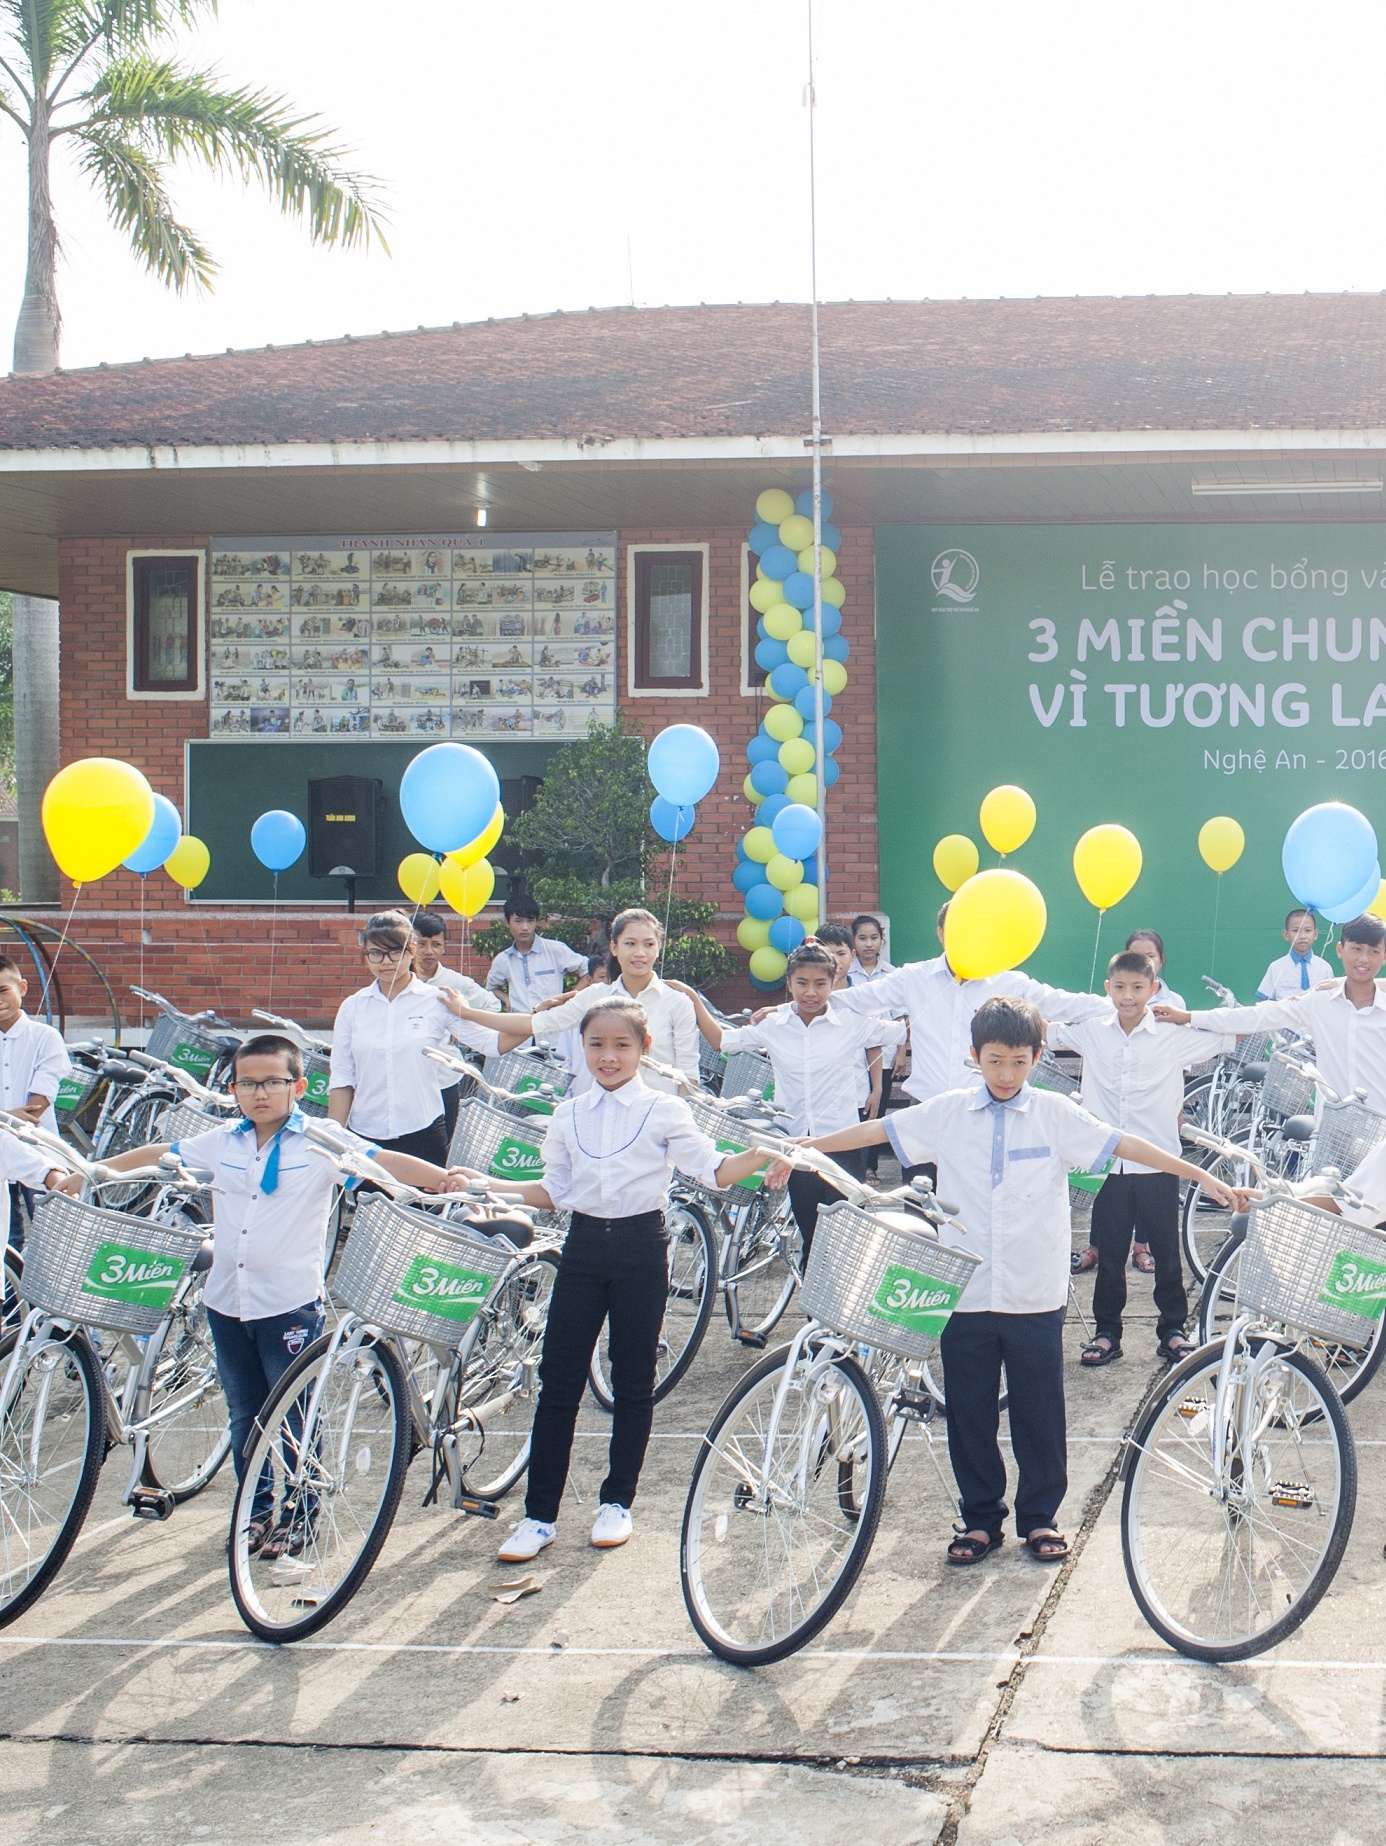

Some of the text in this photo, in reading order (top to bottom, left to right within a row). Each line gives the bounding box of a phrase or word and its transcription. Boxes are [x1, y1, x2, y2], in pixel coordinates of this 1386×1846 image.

[1081, 560, 1116, 591] Lễ
[1125, 566, 1191, 590] trao
[1203, 562, 1259, 595] học
[1270, 557, 1348, 597] bổng
[1027, 617, 1059, 663] 3
[1076, 598, 1223, 663] MIỀN
[1028, 668, 1088, 728] VÌ
[1103, 682, 1310, 728] TƯƠNG
[1203, 748, 1267, 776] Nghệ
[1275, 749, 1306, 770] An
